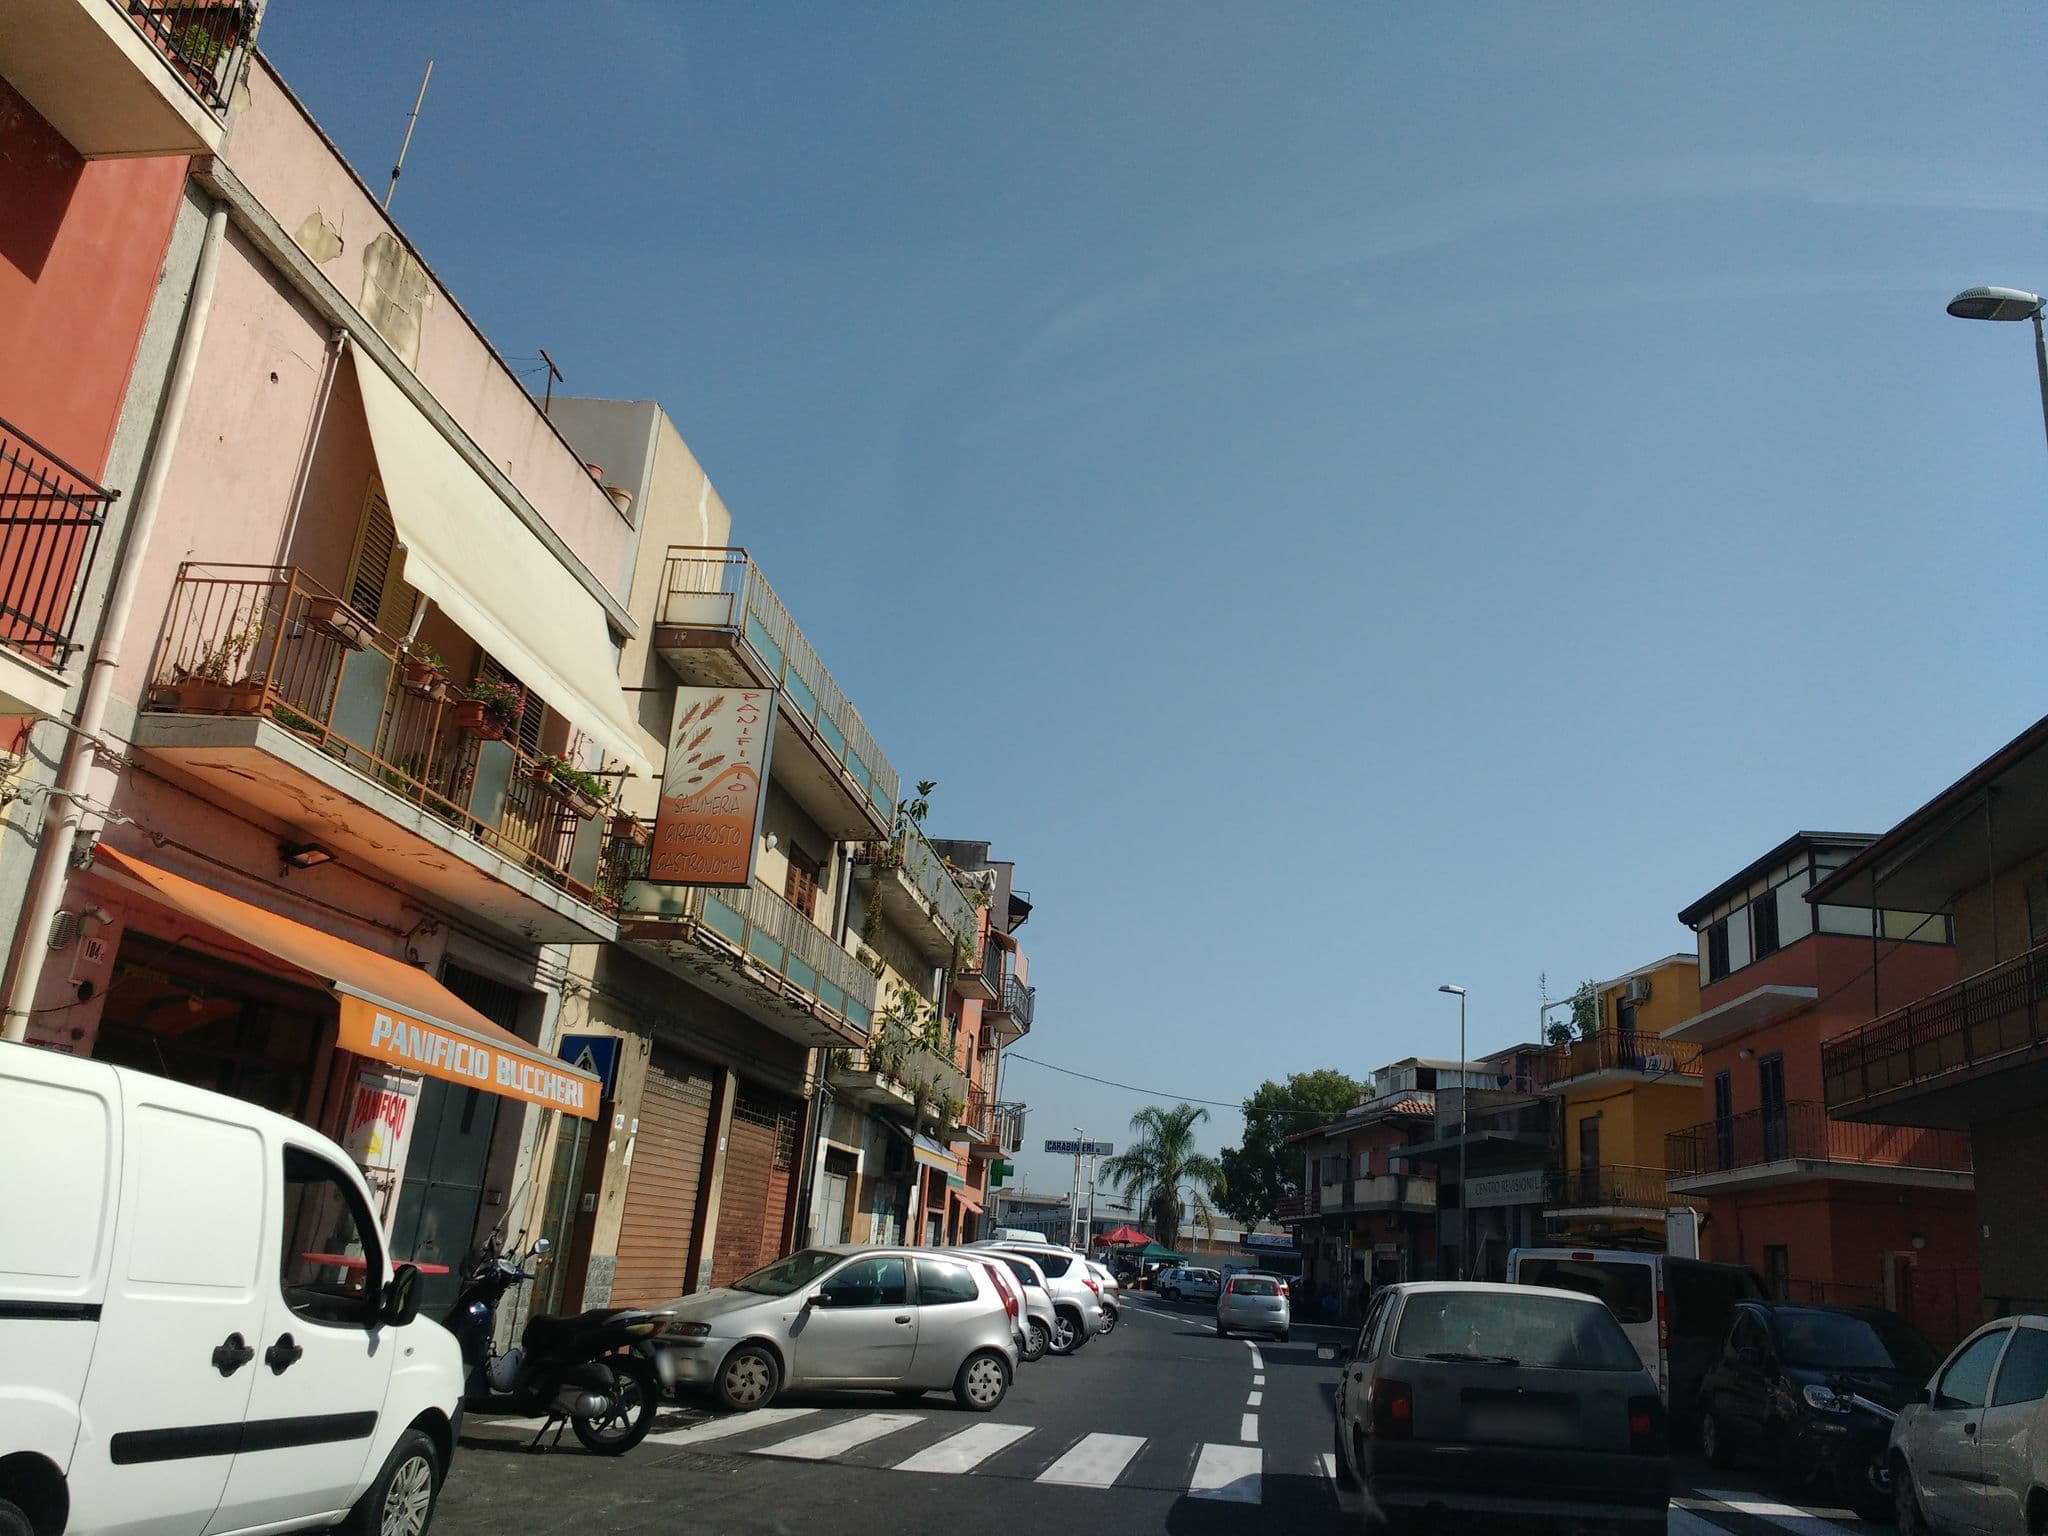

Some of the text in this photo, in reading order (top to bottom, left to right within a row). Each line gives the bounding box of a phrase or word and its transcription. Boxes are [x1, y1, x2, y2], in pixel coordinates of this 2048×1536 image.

[673, 794, 740, 816] SALUMERIA
[665, 824, 742, 846] GIRARROSTO
[656, 853, 741, 875] GASTRONOMIA
[371, 1013, 585, 1109] PANIFICIO BUCCHERI
[351, 1087, 408, 1141] PANIFICIO
[1047, 1141, 1094, 1152] CARABINERI
